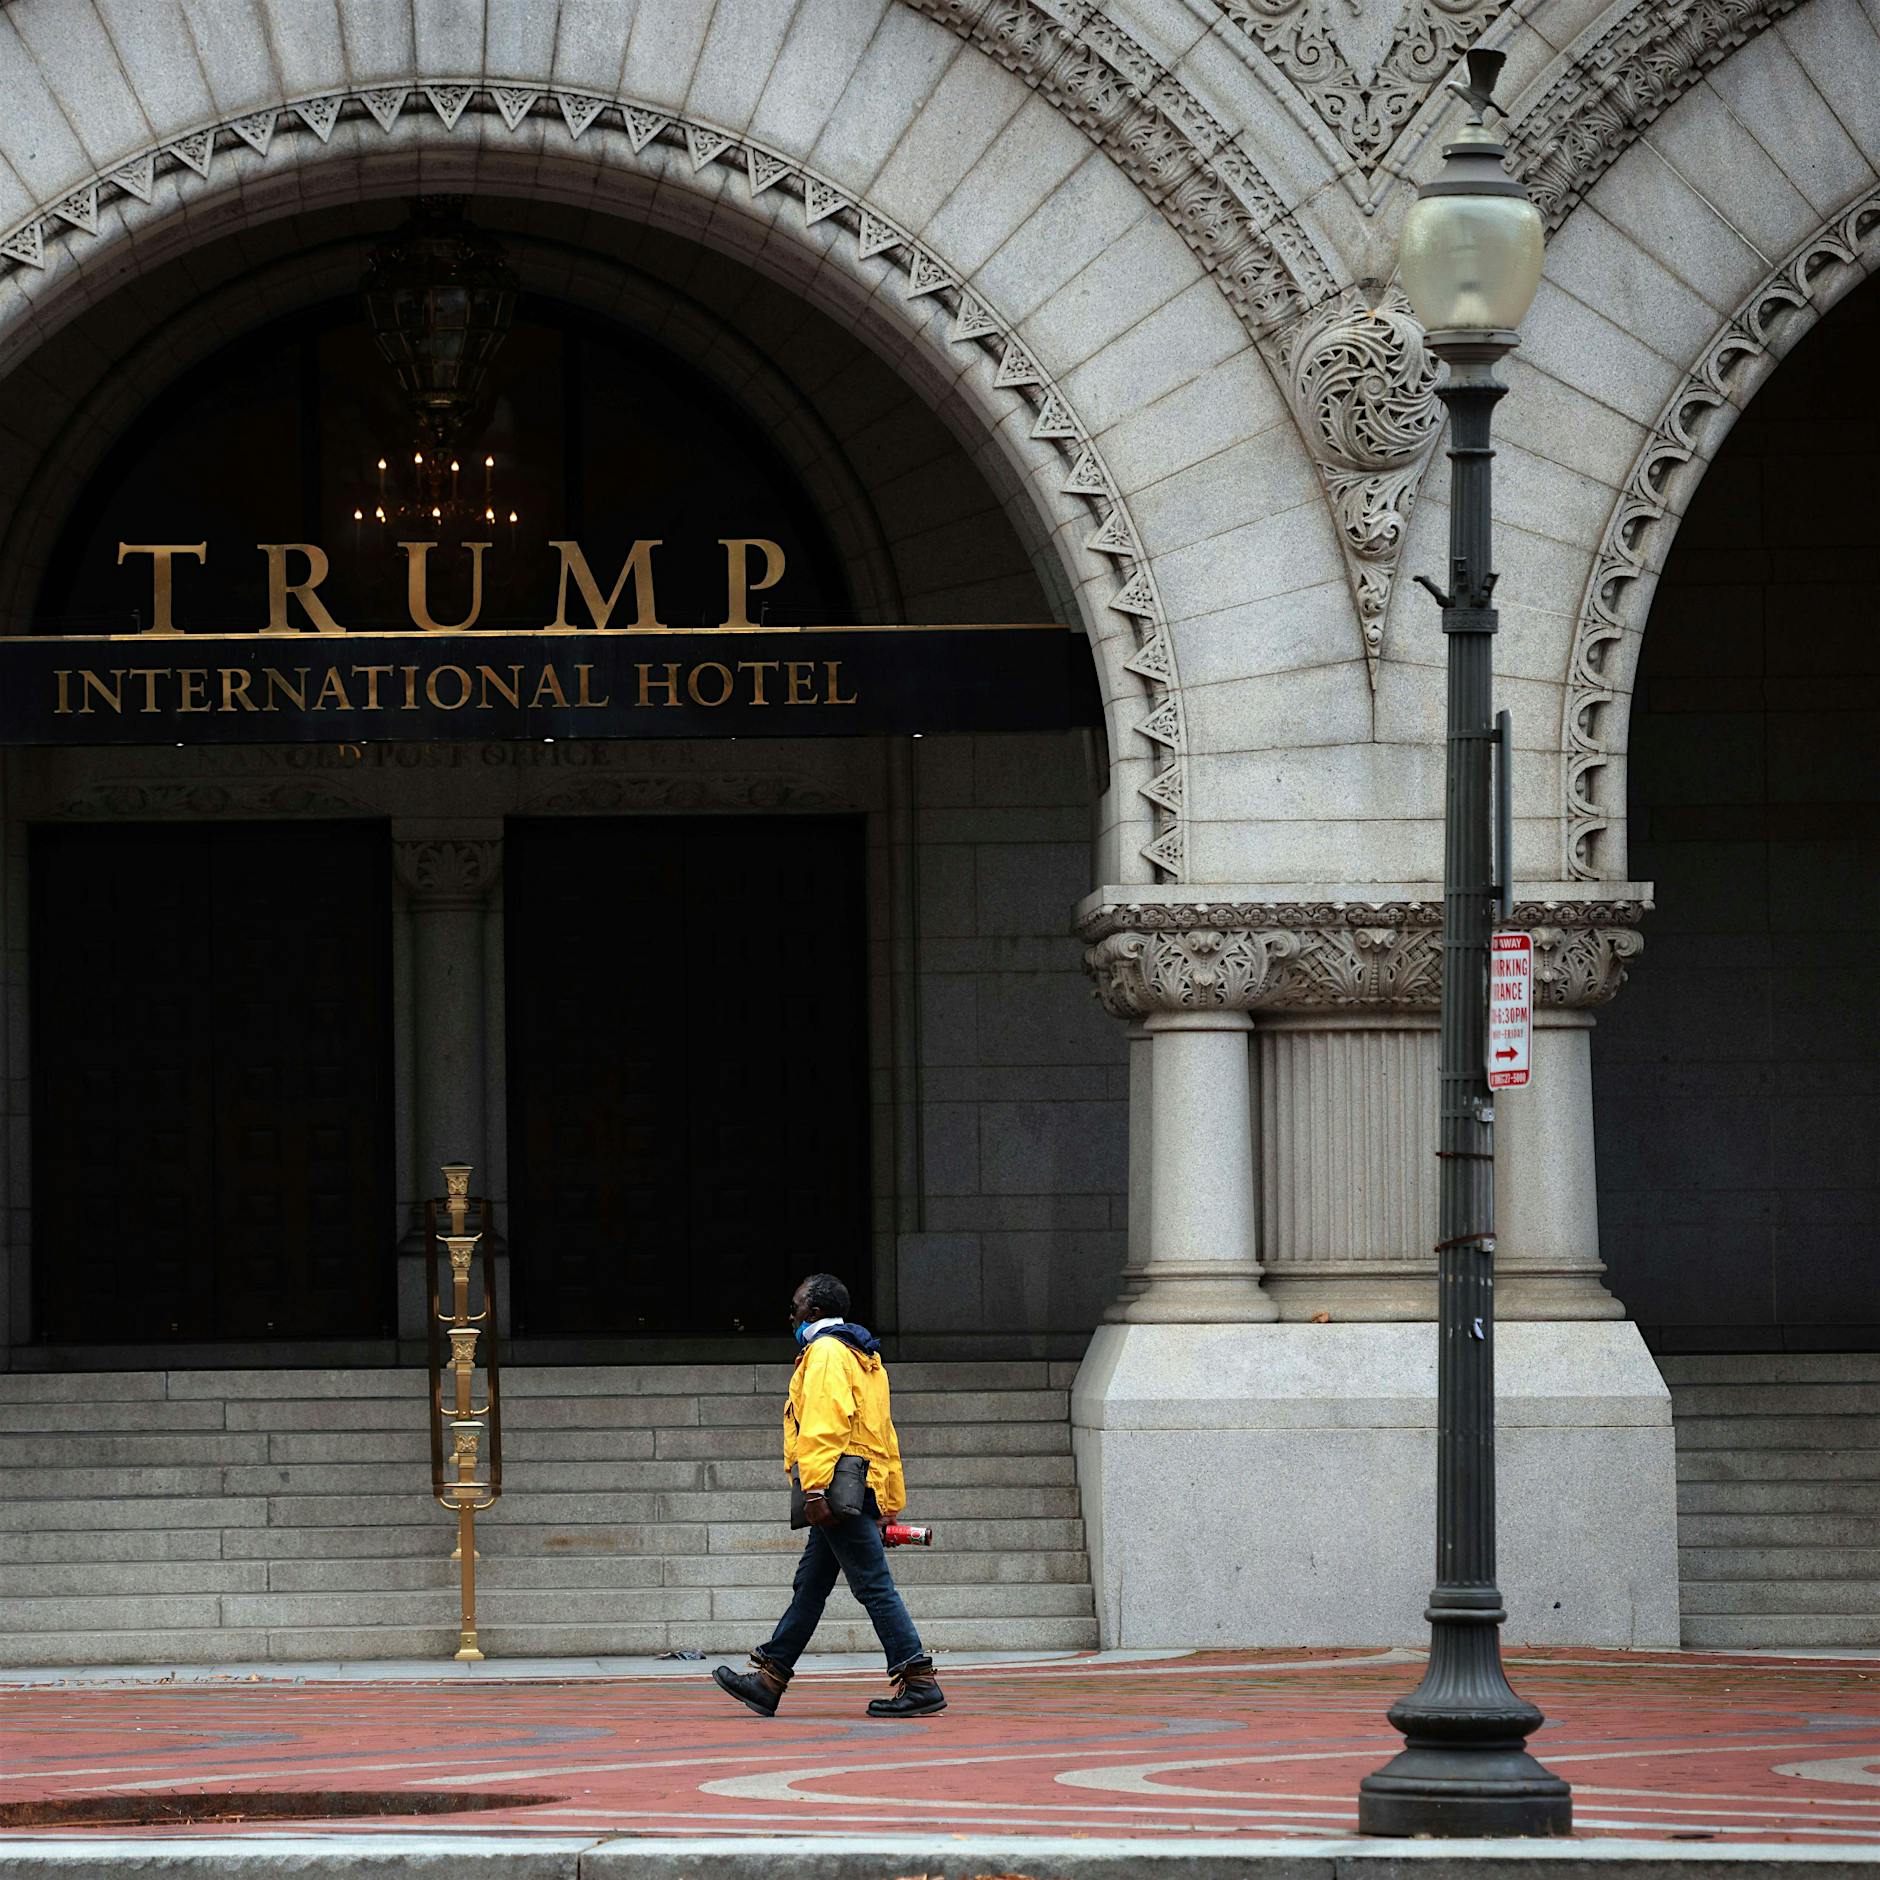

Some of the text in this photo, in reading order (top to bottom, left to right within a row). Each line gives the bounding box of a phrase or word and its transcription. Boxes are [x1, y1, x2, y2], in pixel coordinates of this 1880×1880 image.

[117, 538, 787, 635] TRUMP
[54, 661, 858, 714] INTERNATIONAL HOTEL
